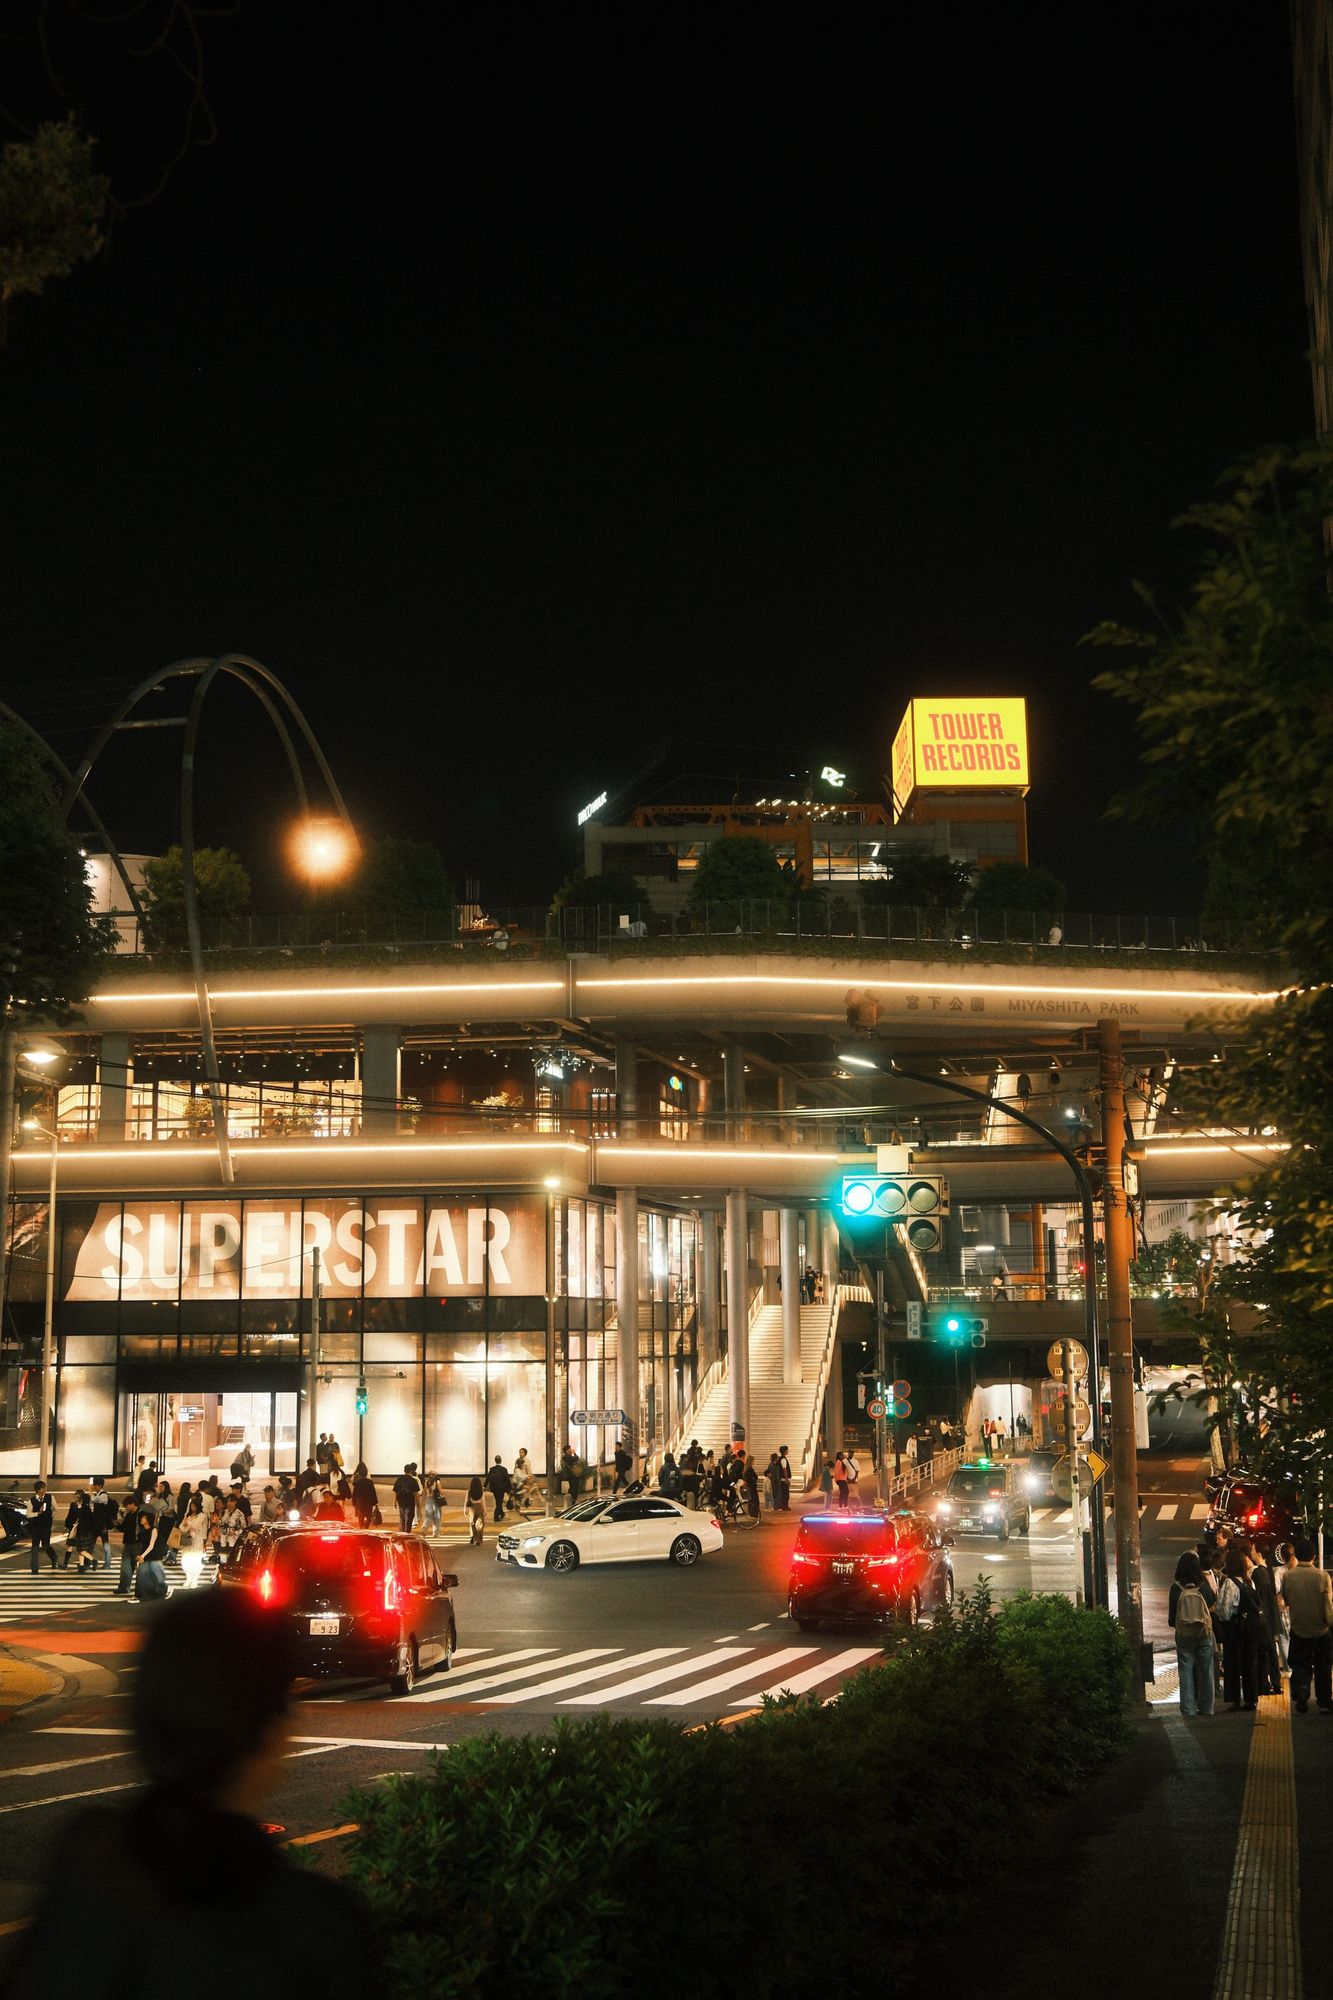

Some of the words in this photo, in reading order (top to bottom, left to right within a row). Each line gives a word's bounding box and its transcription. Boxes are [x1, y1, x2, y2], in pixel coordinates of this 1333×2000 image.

[928, 713, 1004, 740] TOWER
[922, 744, 1021, 771] RECORDS
[905, 995, 984, 1012] 宮下公園
[1009, 999, 1090, 1013] MIYASHITA
[1100, 1002, 1139, 1015] PARK
[101, 1208, 512, 1290] SUPERSTAR
[872, 1404, 884, 1414] 40
